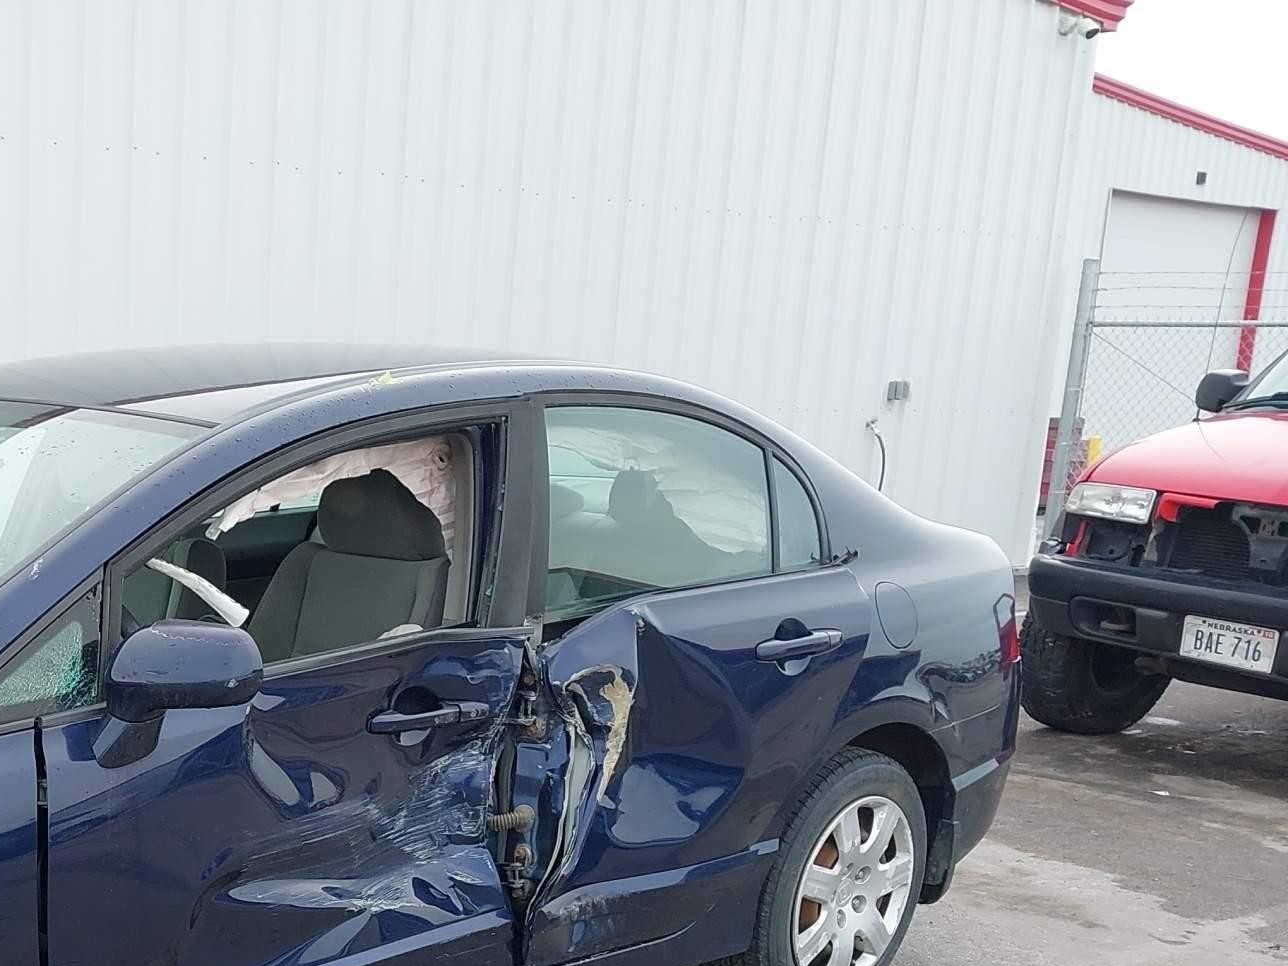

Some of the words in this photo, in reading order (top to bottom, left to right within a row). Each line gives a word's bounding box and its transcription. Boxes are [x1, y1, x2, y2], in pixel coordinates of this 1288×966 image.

[1207, 622, 1255, 636] NEBRASKA
[1193, 629, 1226, 655] BAE
[1231, 636, 1262, 662] 716
